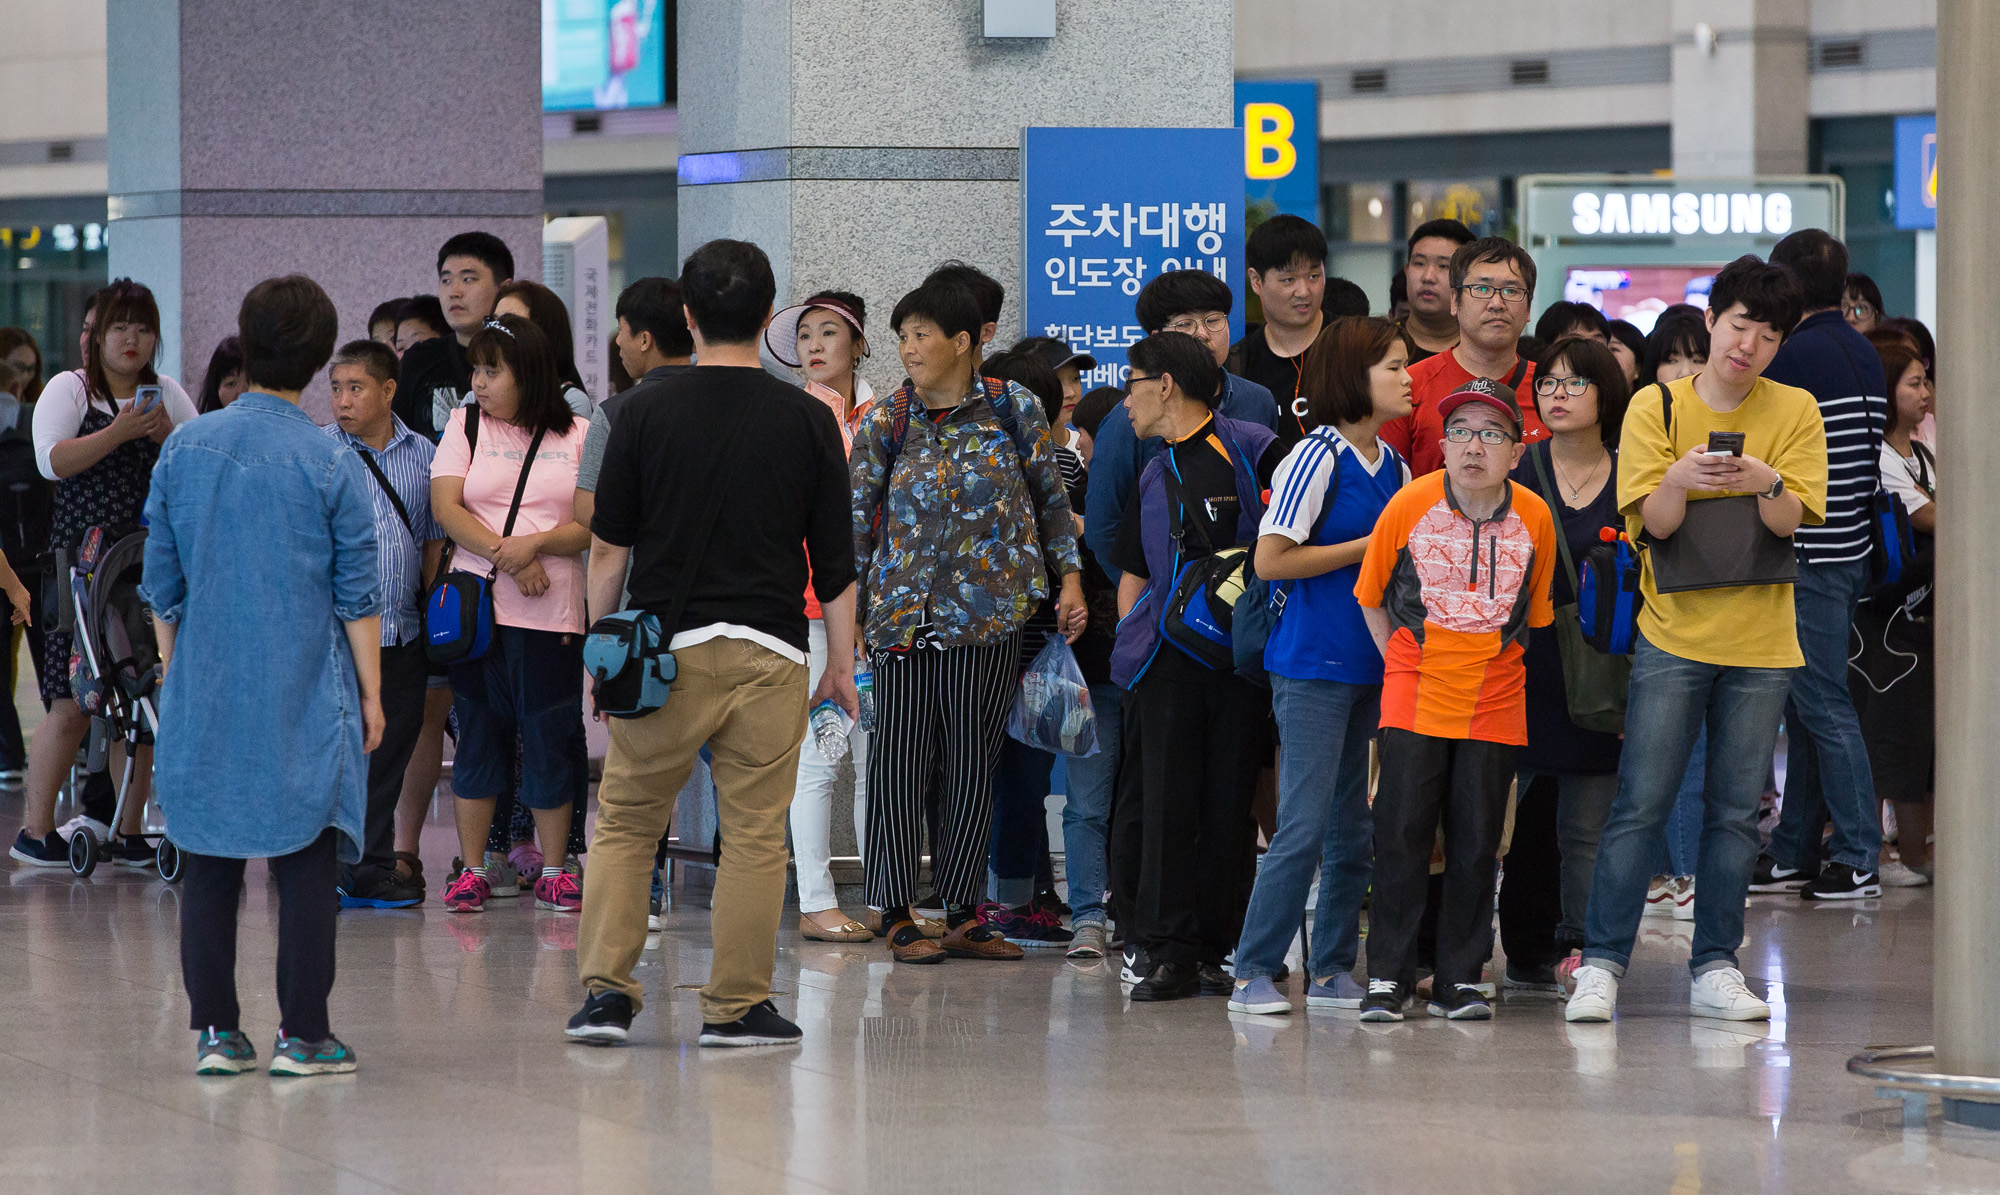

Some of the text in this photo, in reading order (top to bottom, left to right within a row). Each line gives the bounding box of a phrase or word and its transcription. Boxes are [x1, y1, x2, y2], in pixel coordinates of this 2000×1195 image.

[1244, 102, 1298, 180] B
[1044, 202, 1227, 255] 주차대행
[1571, 191, 1793, 236] SAMSUNG
[1044, 256, 1148, 296] 인도장
